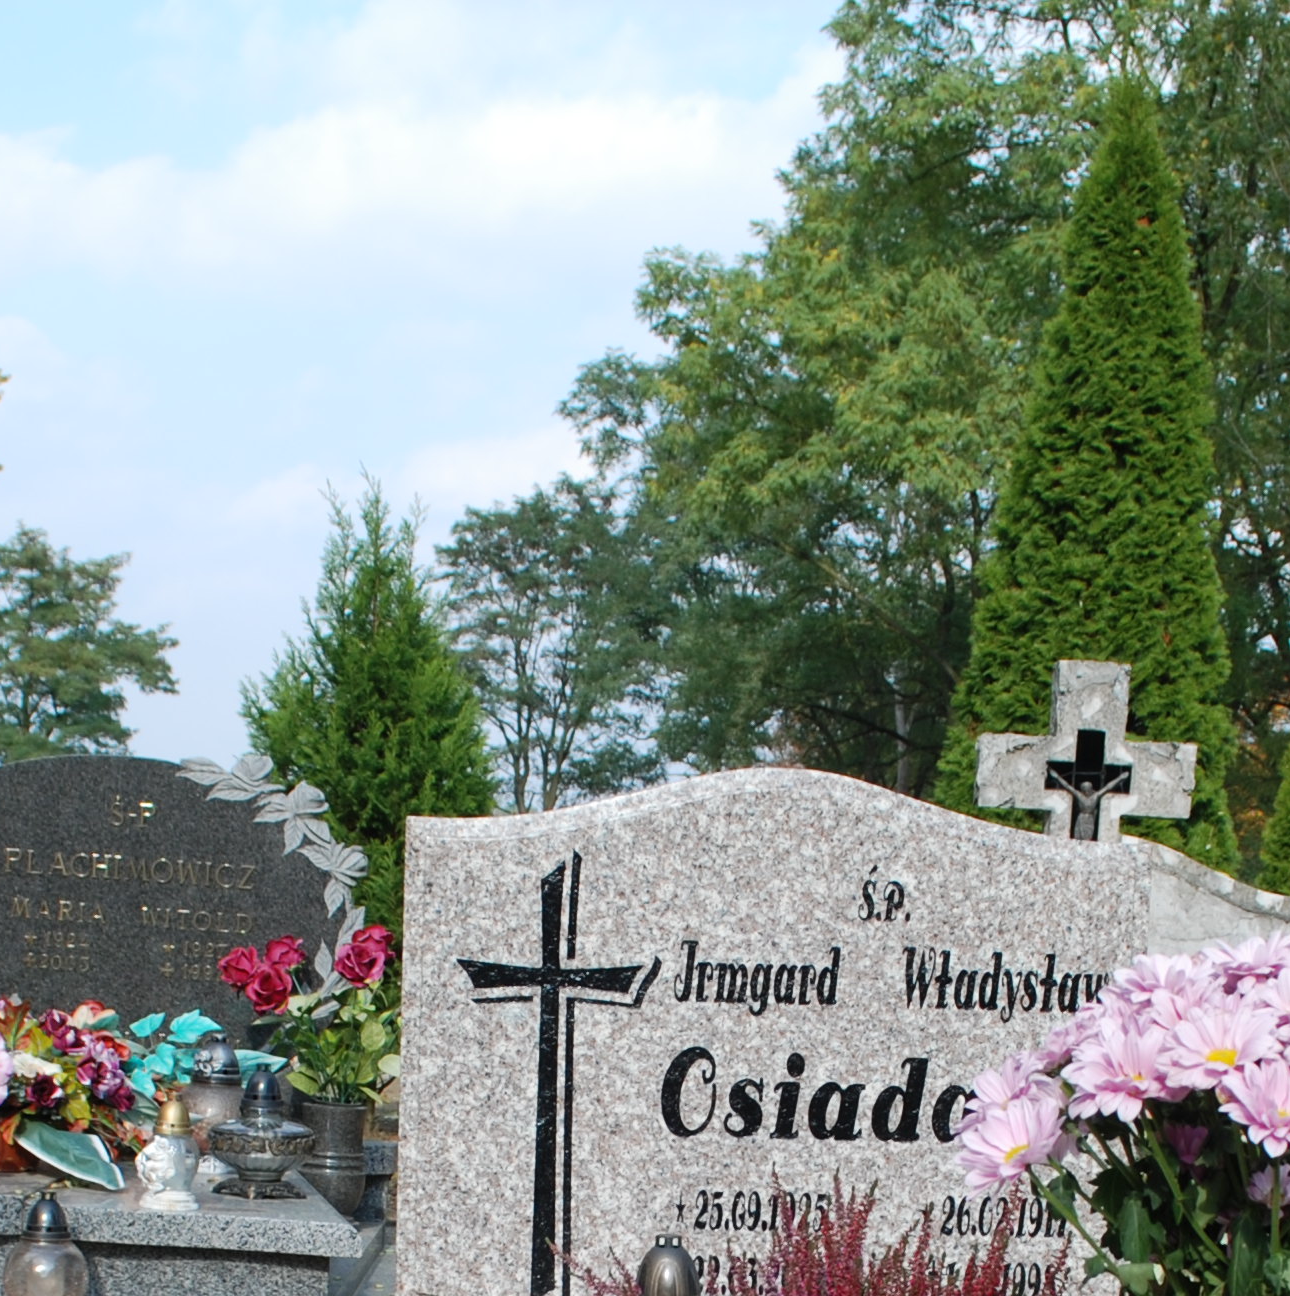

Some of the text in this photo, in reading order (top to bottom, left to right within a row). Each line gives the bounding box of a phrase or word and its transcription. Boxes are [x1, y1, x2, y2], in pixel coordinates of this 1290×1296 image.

[11, 897, 252, 934] MARIA WITOLD
[858, 865, 911, 921] Ś.P.
